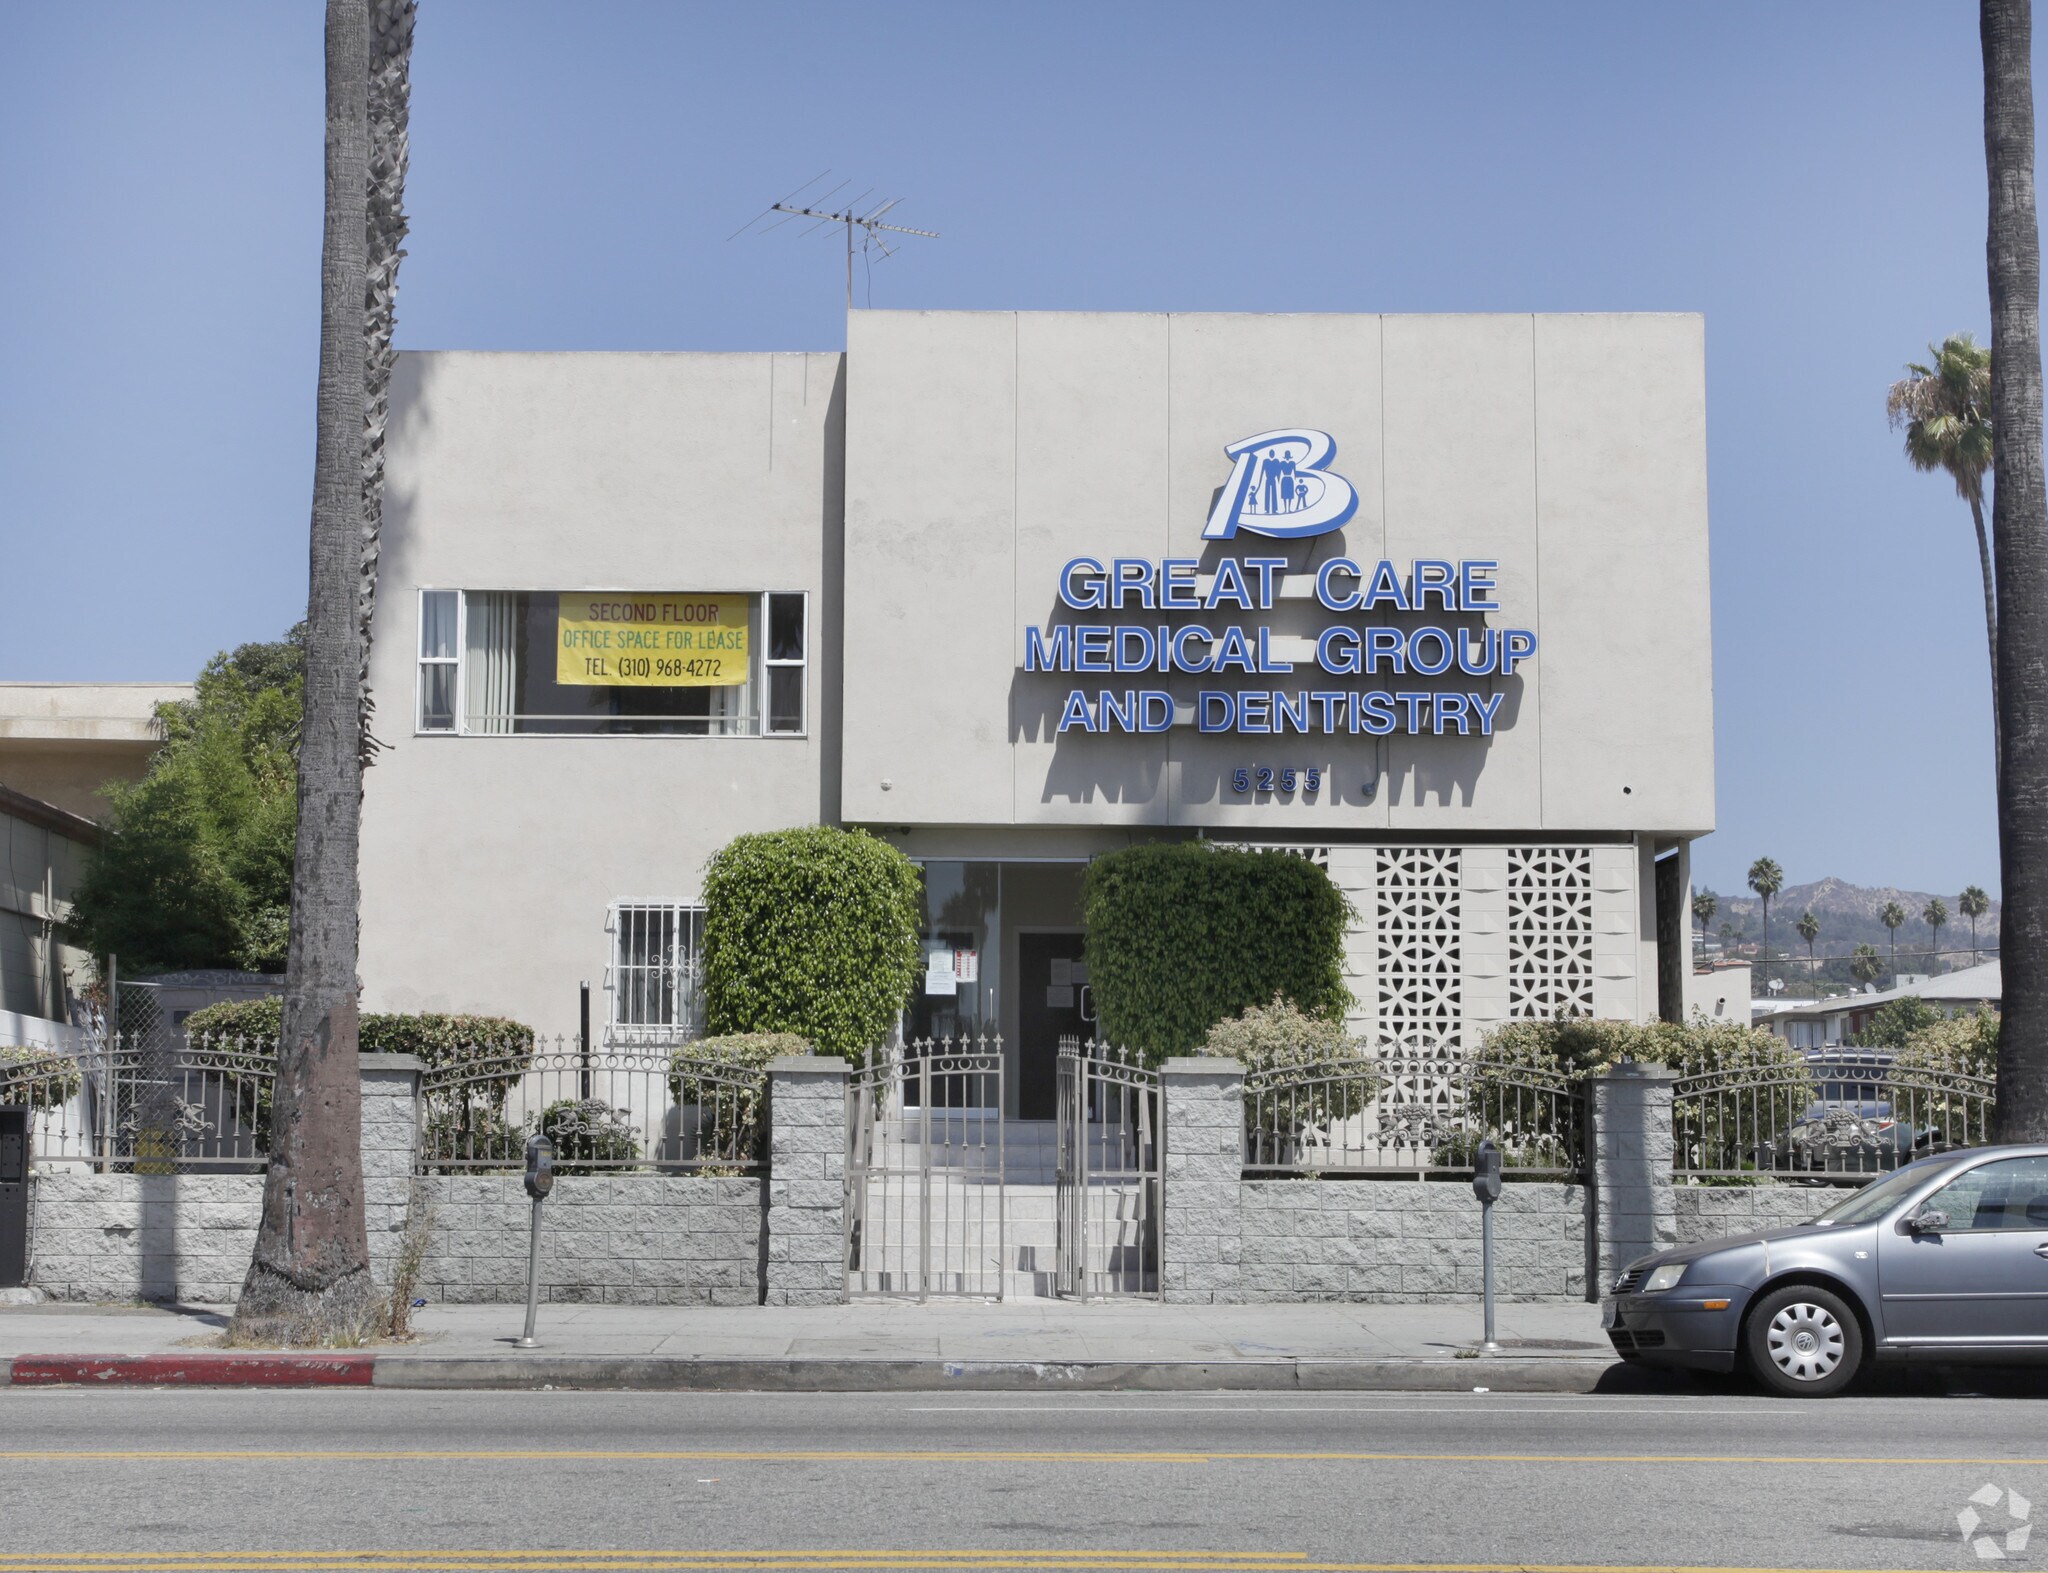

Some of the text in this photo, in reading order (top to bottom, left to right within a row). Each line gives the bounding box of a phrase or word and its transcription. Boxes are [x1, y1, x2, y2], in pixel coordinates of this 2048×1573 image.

[1058, 557, 1502, 612] GREAT CARE
[589, 603, 719, 622] SECOND FLOOR
[563, 629, 743, 650] OFFICE SPACE FOR LEASE
[1024, 624, 1538, 676] MEDICAL GROUP
[585, 657, 721, 678] TEL. (310) 968-4272
[1059, 689, 1505, 736] AND DENTISTRY
[1233, 767, 1321, 793] 5255
